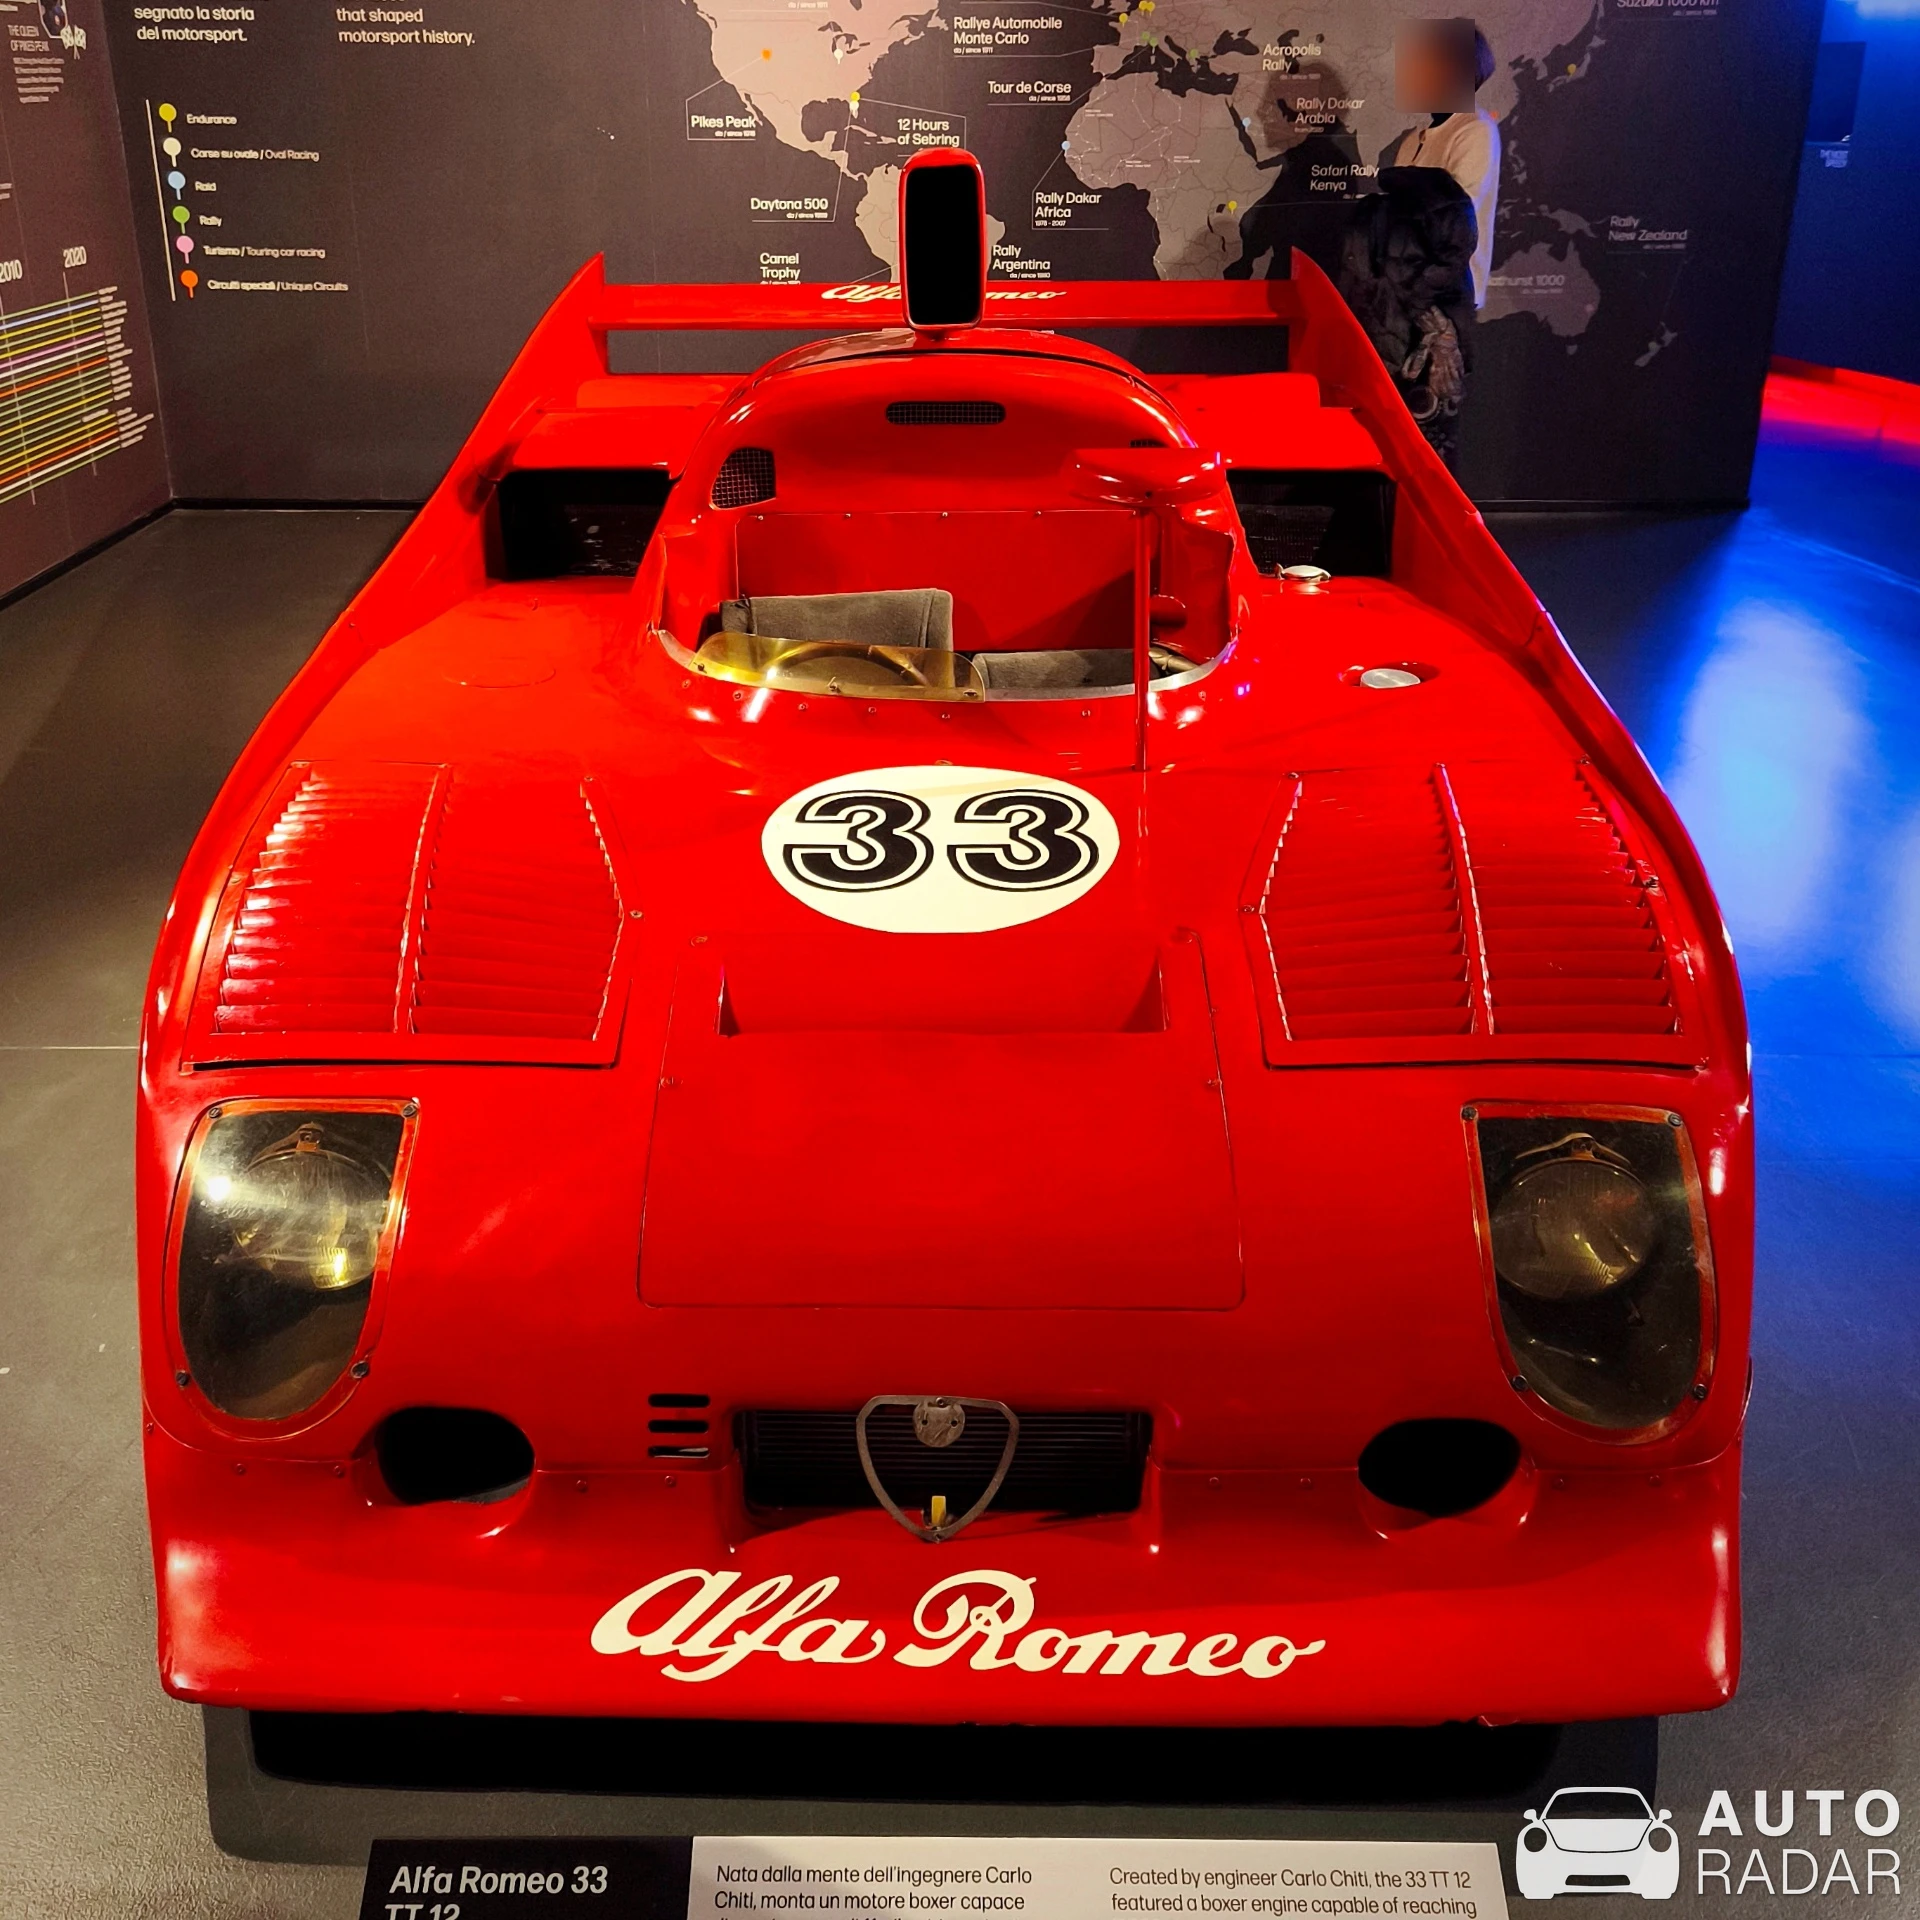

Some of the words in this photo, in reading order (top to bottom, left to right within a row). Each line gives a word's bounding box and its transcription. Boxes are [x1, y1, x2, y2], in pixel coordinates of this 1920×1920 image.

[134, 7, 194, 22] segnato
[196, 6, 210, 20] la
[213, 7, 255, 21] storia
[336, 8, 366, 22] that
[369, 8, 424, 25] shaped
[953, 16, 990, 31] Rallye
[992, 16, 1062, 29] Automobile
[137, 26, 159, 40] del
[162, 27, 247, 43] motorsport.
[338, 30, 420, 45] motorsport
[423, 29, 476, 46] history.
[953, 31, 993, 44] Monte
[994, 32, 1029, 45] Carlo
[1263, 43, 1322, 58] Acropolis
[1262, 59, 1292, 73] Rally
[987, 80, 1014, 93] Tour
[1015, 80, 1032, 93] de
[1033, 81, 1072, 94] Corse
[1296, 97, 1326, 111] Rally
[1328, 97, 1365, 110] Dakar
[186, 113, 237, 125] Endurance
[691, 115, 724, 128] Pikes
[725, 115, 756, 128] Peak
[897, 118, 911, 131] 12
[912, 118, 950, 131] Hours
[1295, 112, 1336, 124] Arabia
[897, 133, 910, 145] of
[912, 133, 960, 147] Sebring
[220, 150, 233, 159] su
[264, 149, 286, 160] Oval
[287, 150, 320, 162] Racing
[1311, 164, 1348, 177] Safari
[1350, 164, 1380, 178] Rally
[1309, 179, 1347, 192] Kenya
[750, 197, 802, 212] Daytona
[804, 198, 829, 210] 500
[1035, 192, 1064, 206] Rally
[1065, 192, 1102, 204] Dakar
[1034, 206, 1072, 218] Africa
[199, 215, 222, 227] Rally
[1610, 215, 1640, 228] Rally
[1608, 230, 1636, 241] New
[1638, 229, 1687, 241] Zealand
[203, 245, 240, 257] Turismo
[246, 246, 279, 259] Touring
[280, 248, 296, 257] car
[296, 248, 326, 259] racing
[992, 244, 1022, 258] Rally
[0, 259, 23, 284] 2010
[63, 246, 87, 269] 2020
[760, 252, 799, 265] Camel
[992, 258, 1051, 272] Argentina
[760, 266, 800, 280] Trophy
[1536, 274, 1565, 286] 1000
[281, 281, 313, 292] Unique
[313, 281, 349, 292] Circuits
[985, 291, 1067, 300] meo
[782, 788, 1100, 893] 33
[591, 1567, 886, 1682] Alfa
[893, 1569, 1326, 1679] Romeo
[389, 1865, 453, 1894] Alfa
[460, 1866, 565, 1894] Romeo
[571, 1865, 608, 1894] 33
[716, 1865, 758, 1883] Nata
[761, 1865, 802, 1883] dalla
[806, 1867, 860, 1883] mente
[863, 1865, 982, 1888] dell'ingegnere
[985, 1866, 1032, 1884] Carlo
[1109, 1867, 1178, 1886] Created
[1181, 1868, 1201, 1889] by
[1204, 1868, 1278, 1889] engineer
[1281, 1869, 1327, 1887] Carlo
[1330, 1869, 1372, 1890] Chiti,
[1374, 1870, 1402, 1888] the
[1405, 1870, 1428, 1888] 33
[1429, 1870, 1451, 1888] TT
[1454, 1870, 1471, 1889] 12
[714, 1890, 757, 1911] Chiti,
[760, 1893, 815, 1909] monta
[819, 1896, 840, 1910] un
[844, 1893, 905, 1910] motore
[909, 1891, 957, 1910] boxer
[960, 1896, 1025, 1913] capace
[1111, 1893, 1183, 1912] featured
[1187, 1898, 1198, 1911] a
[1200, 1894, 1247, 1912] boxer
[1250, 1896, 1308, 1916] engine
[1311, 1895, 1380, 1916] capable
[1382, 1895, 1400, 1913] of
[1402, 1896, 1477, 1919] reaching
[384, 1904, 424, 1920] TT
[428, 1904, 461, 1920] 12
